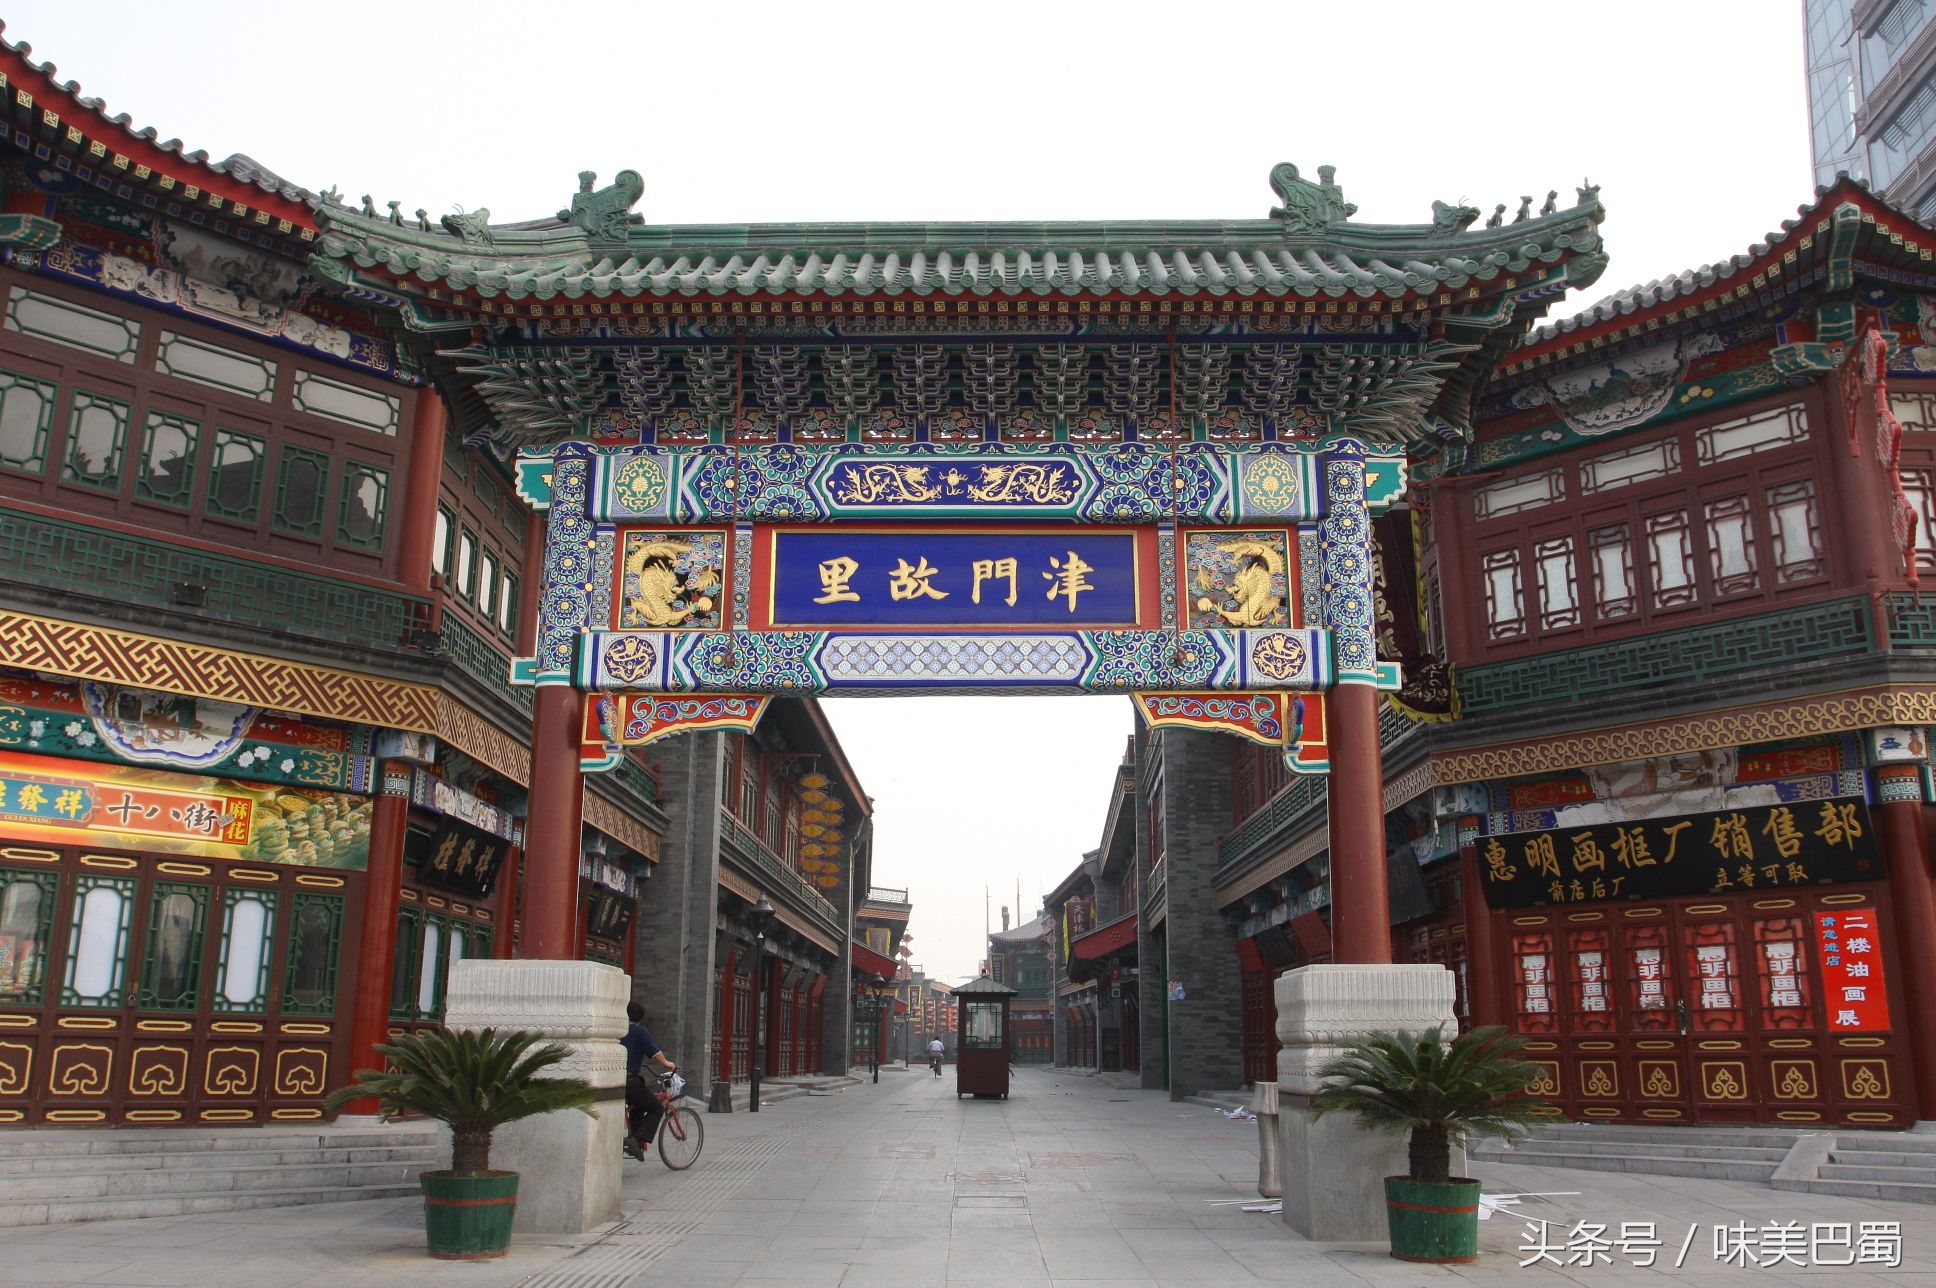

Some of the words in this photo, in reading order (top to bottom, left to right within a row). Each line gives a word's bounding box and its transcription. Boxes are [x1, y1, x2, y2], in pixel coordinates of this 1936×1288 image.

[0, 781, 83, 818] 發祥
[107, 794, 218, 833] 十八街
[226, 801, 248, 840] 麻花
[1485, 801, 1863, 882] 惠明画框厂销售部
[1547, 876, 1625, 901] 前店后厂
[1714, 860, 1808, 888] 立等可取
[1821, 916, 1840, 966] 请您进店
[1835, 916, 1872, 1026] 二楼油画展
